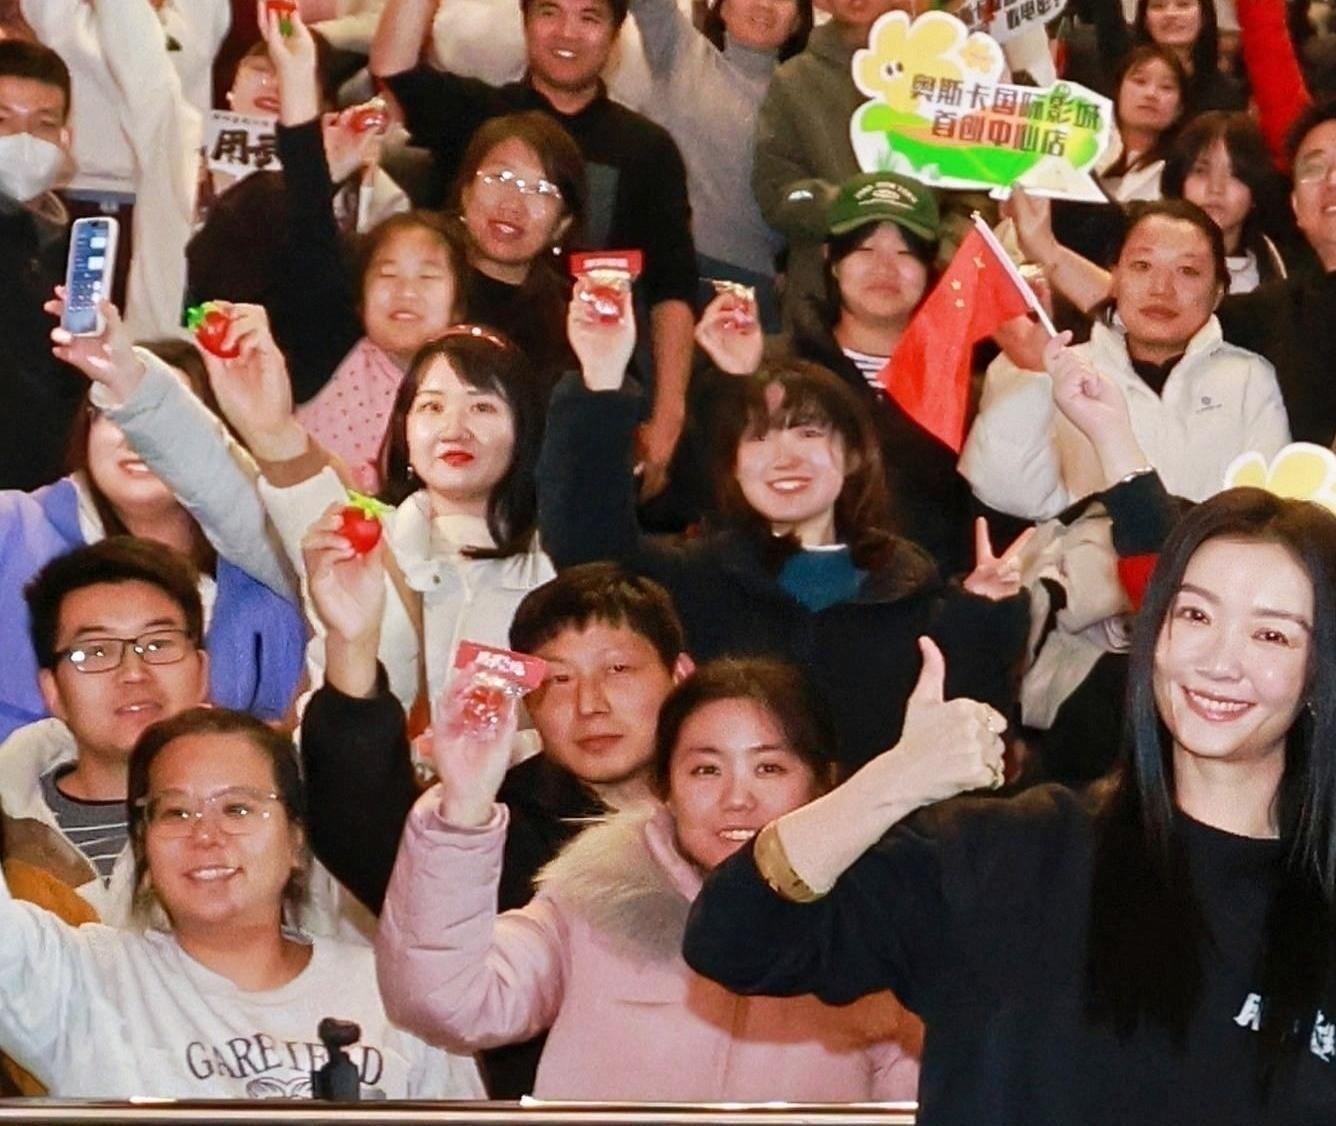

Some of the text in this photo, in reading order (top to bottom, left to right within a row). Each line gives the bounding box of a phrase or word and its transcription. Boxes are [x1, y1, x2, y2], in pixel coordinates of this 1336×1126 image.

[909, 73, 1101, 131] 奥斯卡国际影城
[931, 109, 1068, 158] 首创中心店
